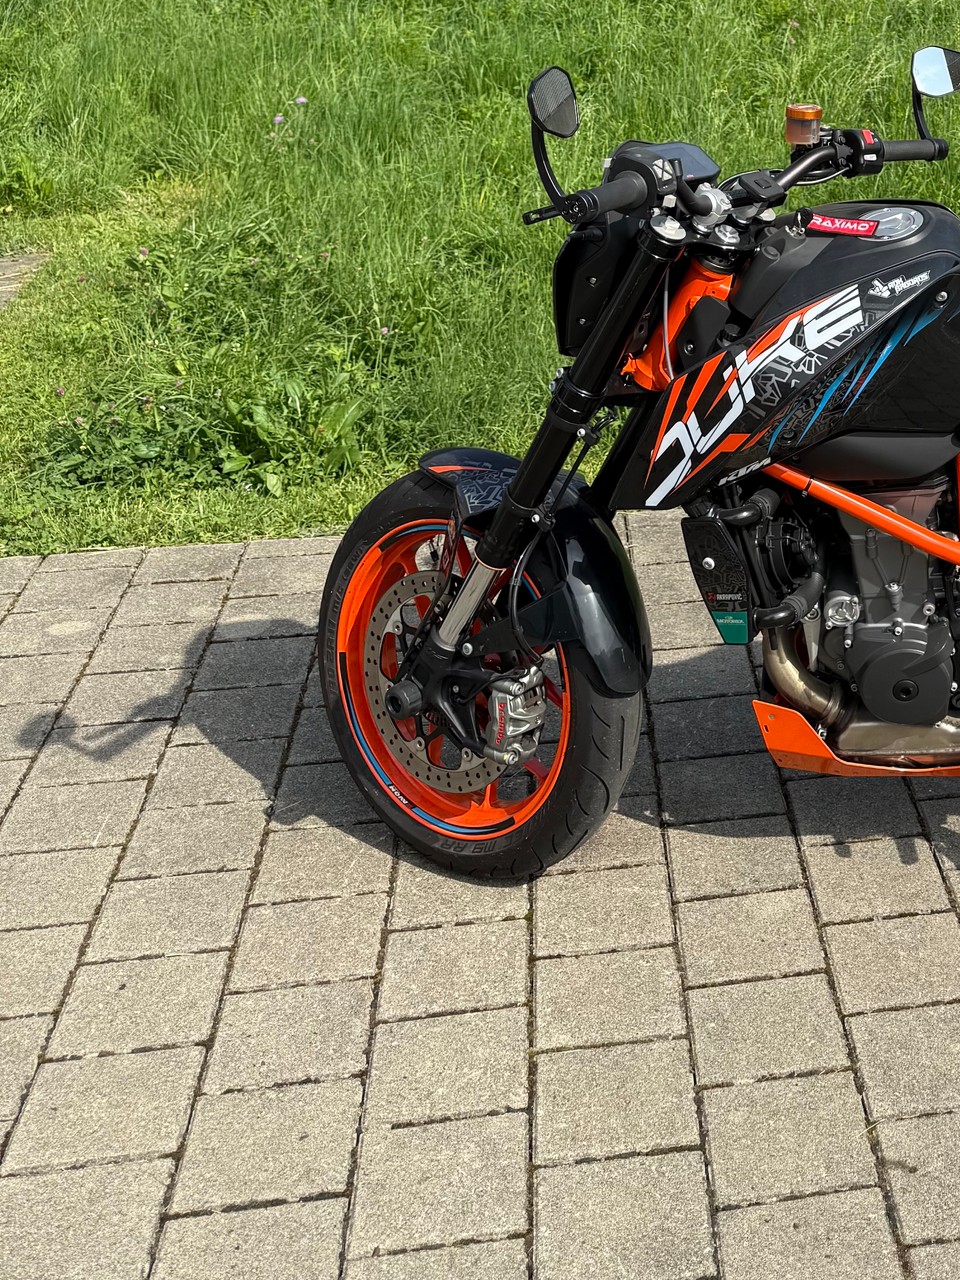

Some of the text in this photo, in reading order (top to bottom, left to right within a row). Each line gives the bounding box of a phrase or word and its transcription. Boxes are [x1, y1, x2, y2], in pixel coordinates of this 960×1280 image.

[644, 283, 864, 507] DUKE
[718, 457, 772, 486] KTM
[495, 702, 507, 746] brembo
